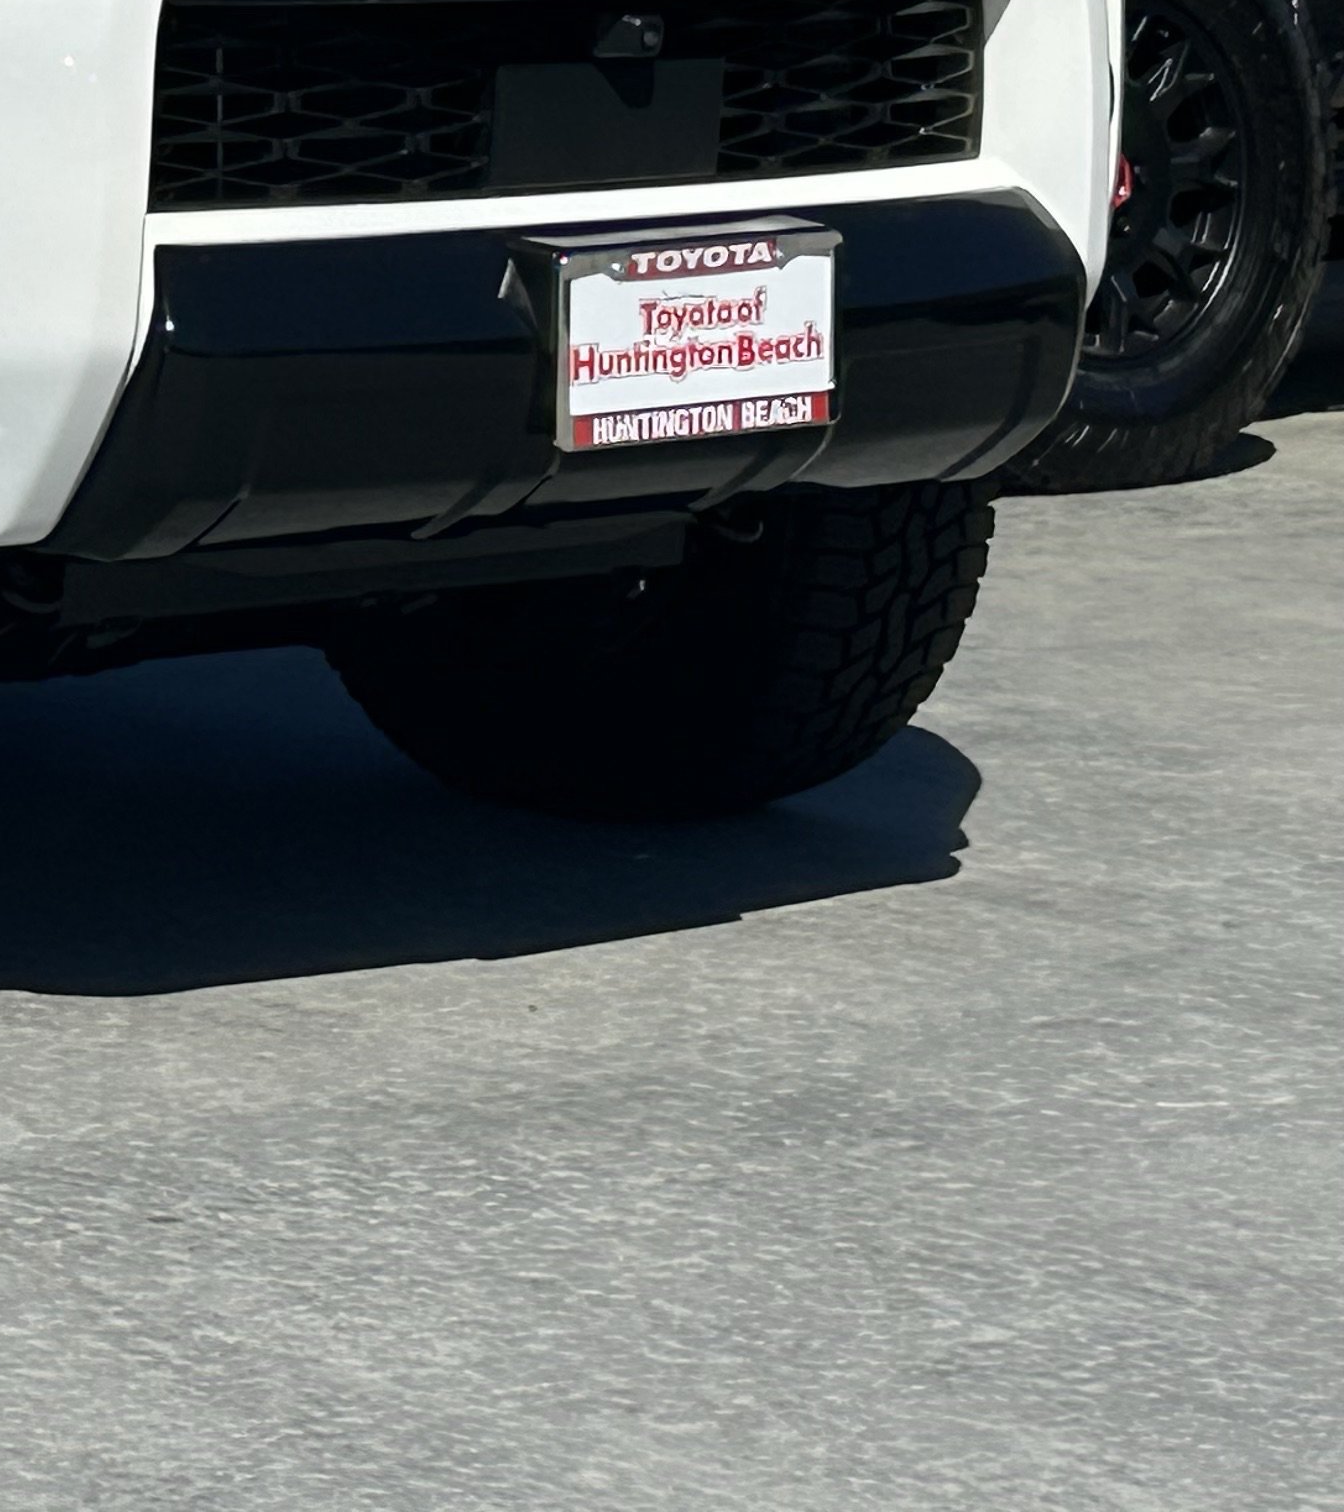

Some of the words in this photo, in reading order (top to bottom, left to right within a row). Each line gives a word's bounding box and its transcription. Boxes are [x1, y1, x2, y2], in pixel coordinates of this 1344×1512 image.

[631, 241, 774, 274] TOYOTA
[639, 297, 736, 336] Toyota
[736, 287, 768, 325] of
[570, 341, 734, 381] Huntington
[735, 322, 825, 368] Beach
[592, 404, 734, 445] HUNTINGTON
[740, 395, 813, 429] BEACH
